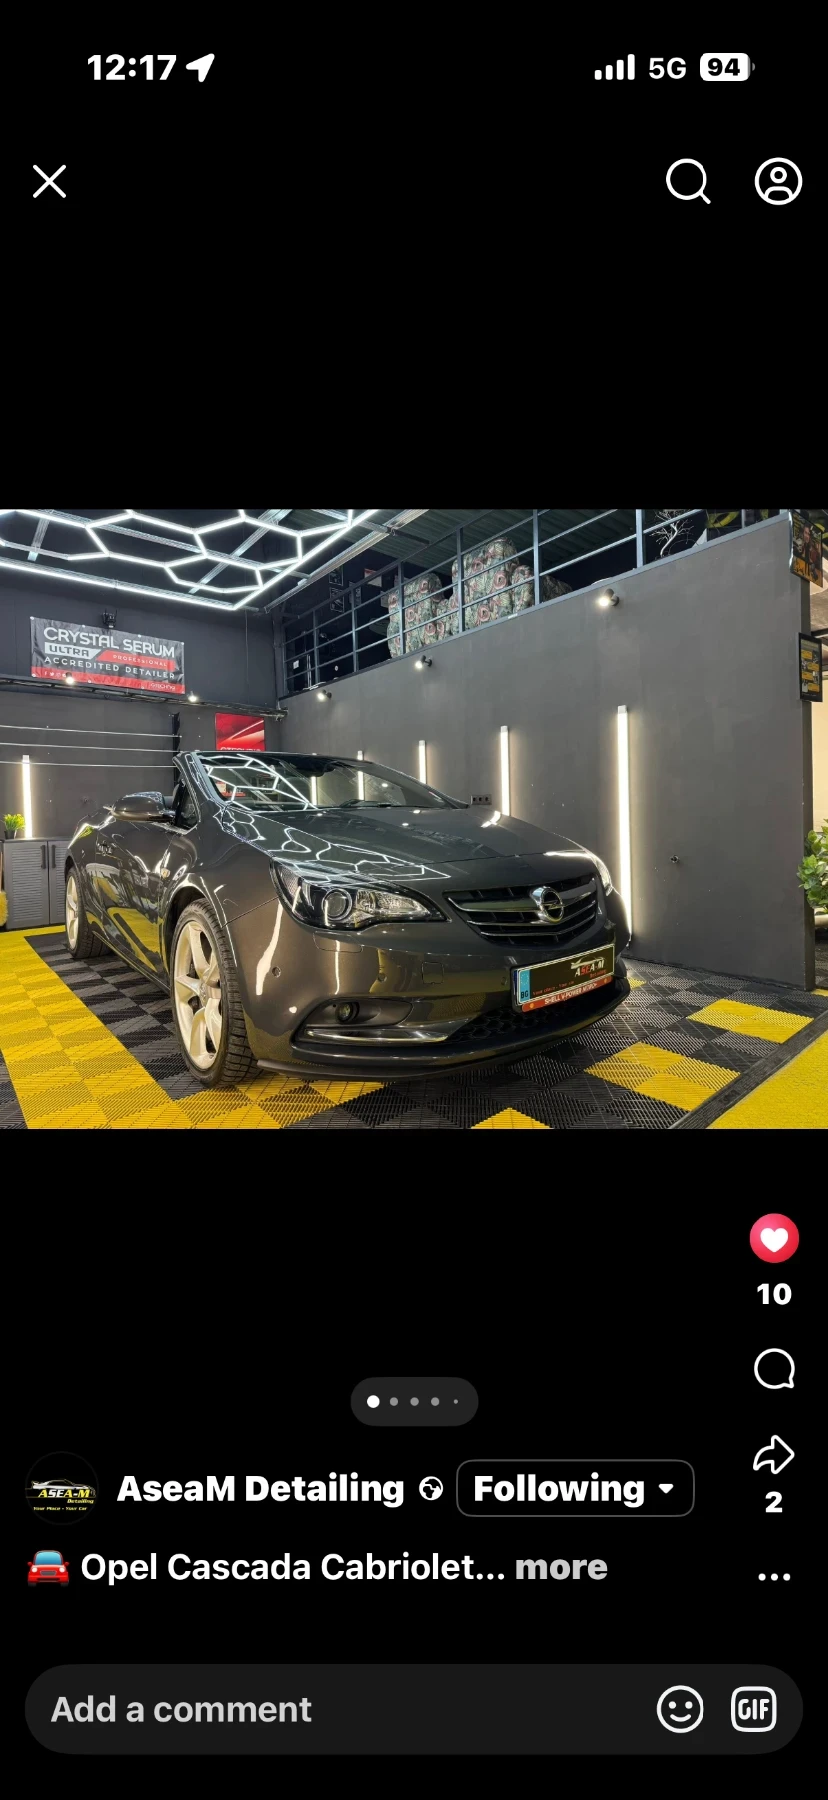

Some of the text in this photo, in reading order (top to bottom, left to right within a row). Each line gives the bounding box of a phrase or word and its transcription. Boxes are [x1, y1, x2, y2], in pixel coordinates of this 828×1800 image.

[43, 627, 175, 658] CRYSTAL SERUM
[49, 644, 90, 658] ULTRA
[112, 654, 168, 667] PROFESSIONAL
[44, 656, 175, 680] ACCREDITED DETAILER
[520, 991, 529, 999] BG
[544, 995, 561, 1005] SHELL
